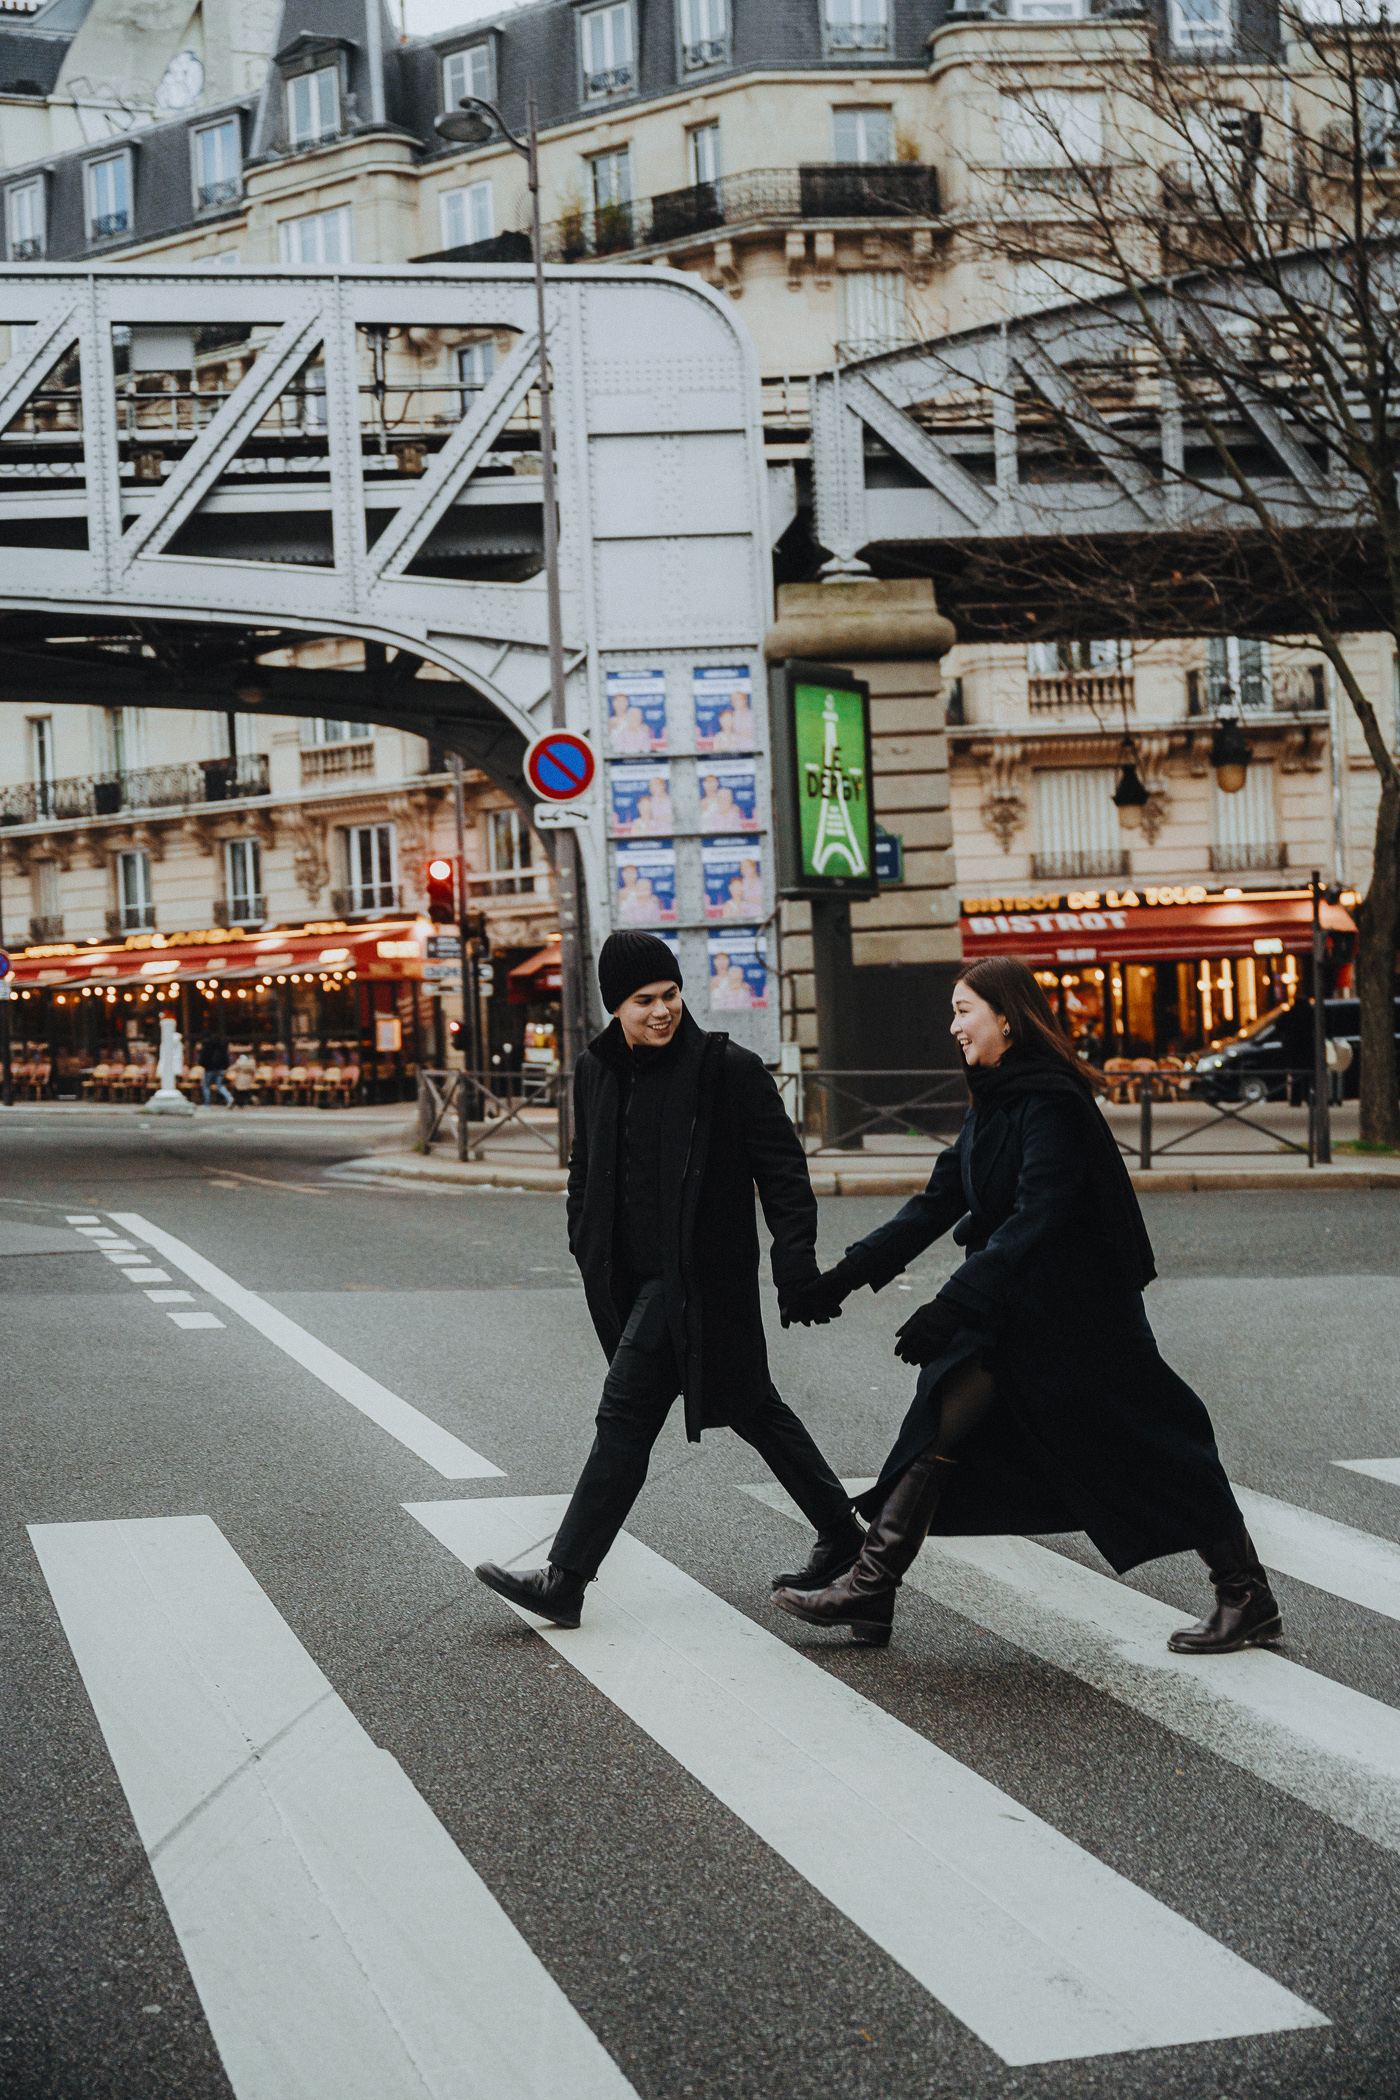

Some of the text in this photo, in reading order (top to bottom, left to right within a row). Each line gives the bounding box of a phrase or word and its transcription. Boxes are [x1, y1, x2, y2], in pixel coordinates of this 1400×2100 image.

[963, 896, 1060, 914] BISTROT
[1067, 890, 1101, 910] DE
[1105, 889, 1140, 908] LA
[969, 912, 1127, 935] BISTROT
